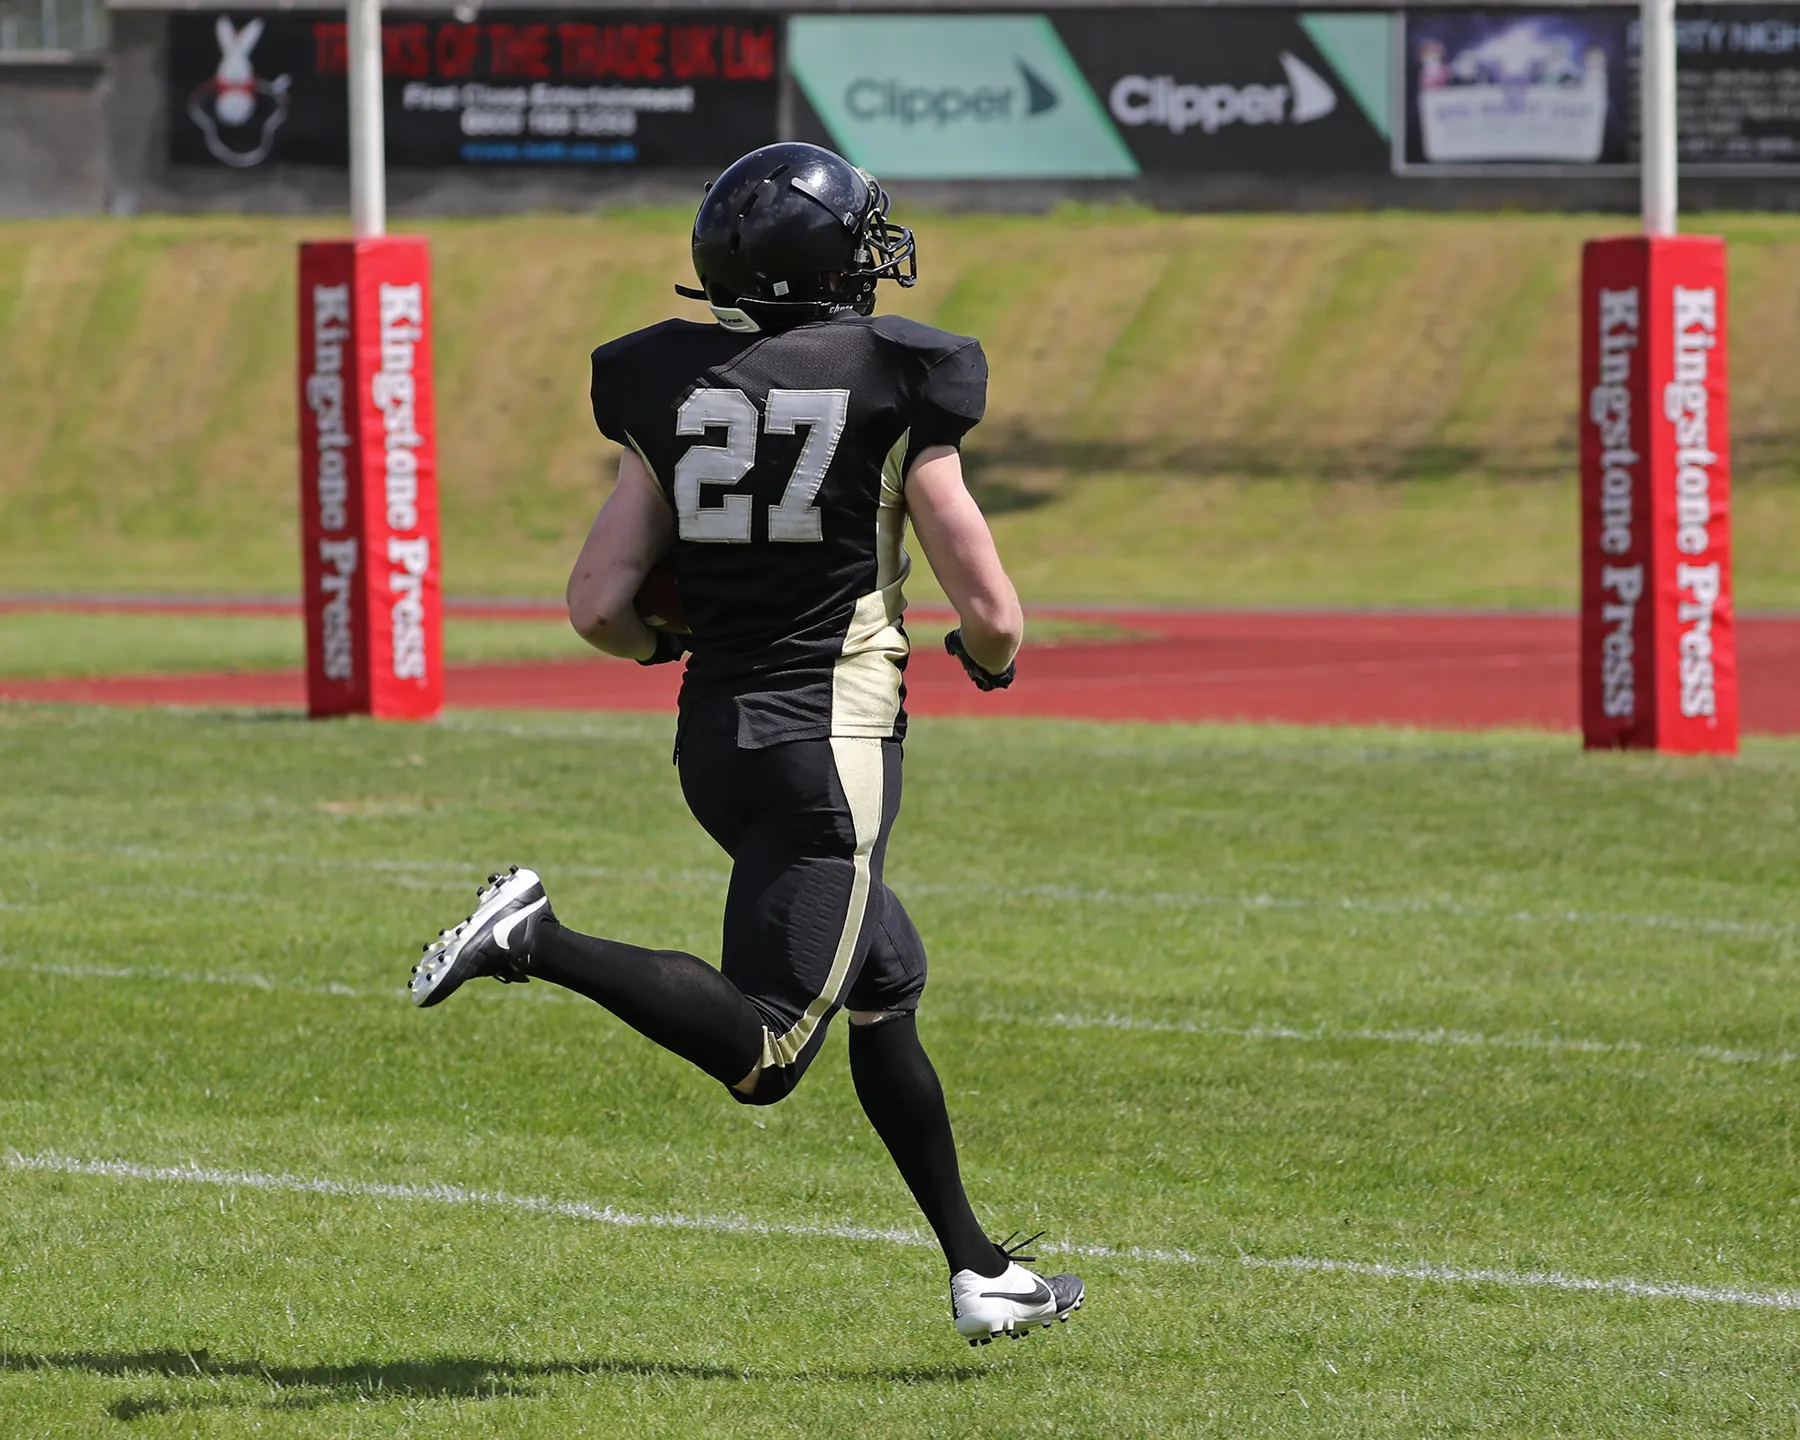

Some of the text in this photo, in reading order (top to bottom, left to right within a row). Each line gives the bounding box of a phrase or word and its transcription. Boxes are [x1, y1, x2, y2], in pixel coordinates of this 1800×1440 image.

[436, 23, 480, 79] OF
[489, 23, 552, 79] THE
[558, 23, 665, 80] TRADE
[844, 77, 1016, 131] Clipper
[1109, 73, 1288, 134] Clipper
[306, 282, 358, 680] Kingstone Press
[372, 281, 430, 680] Kingstone Press
[674, 388, 850, 543] 27
[1589, 286, 1643, 718] Kingstone Press
[1663, 284, 1720, 718] Kingstone Press
